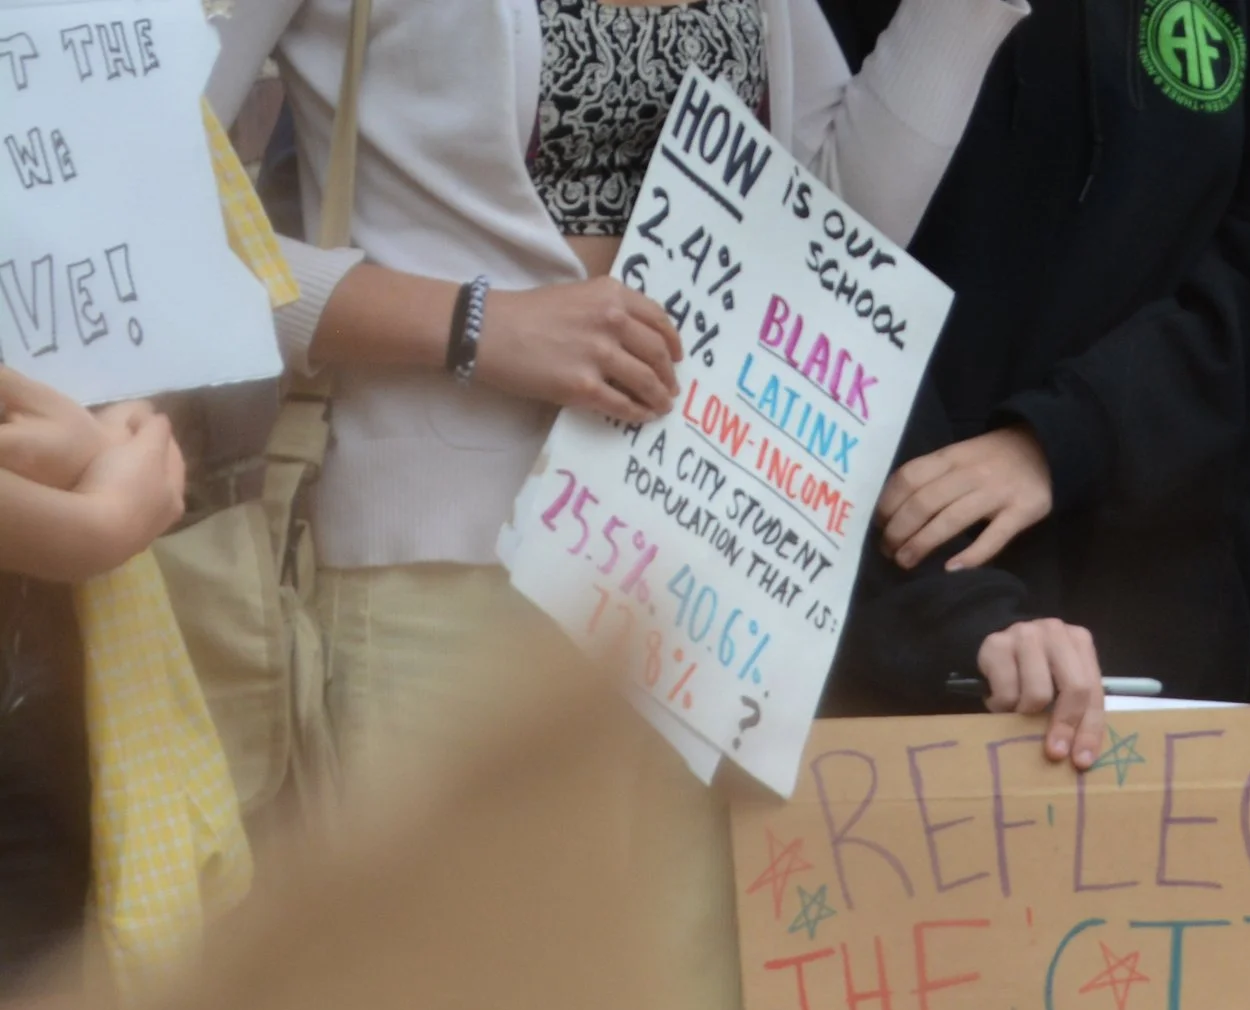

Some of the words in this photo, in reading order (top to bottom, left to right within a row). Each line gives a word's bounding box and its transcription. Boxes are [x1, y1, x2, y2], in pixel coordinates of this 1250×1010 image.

[60, 18, 160, 82] THE
[4, 127, 78, 189] WE
[672, 77, 773, 199] HOW
[637, 186, 742, 311] 2.4%
[757, 294, 879, 420] BLACK
[806, 240, 907, 350] SCHOOL
[682, 378, 854, 536] LOW-INCOME
[736, 353, 859, 474] LATINX
[624, 455, 745, 567] POPULATION
[746, 551, 803, 608] THAT
[805, 600, 838, 632] IS:
[648, 428, 666, 467] A
[677, 447, 726, 502] CITY
[726, 488, 833, 583] STUDENT
[732, 695, 761, 750] ?
